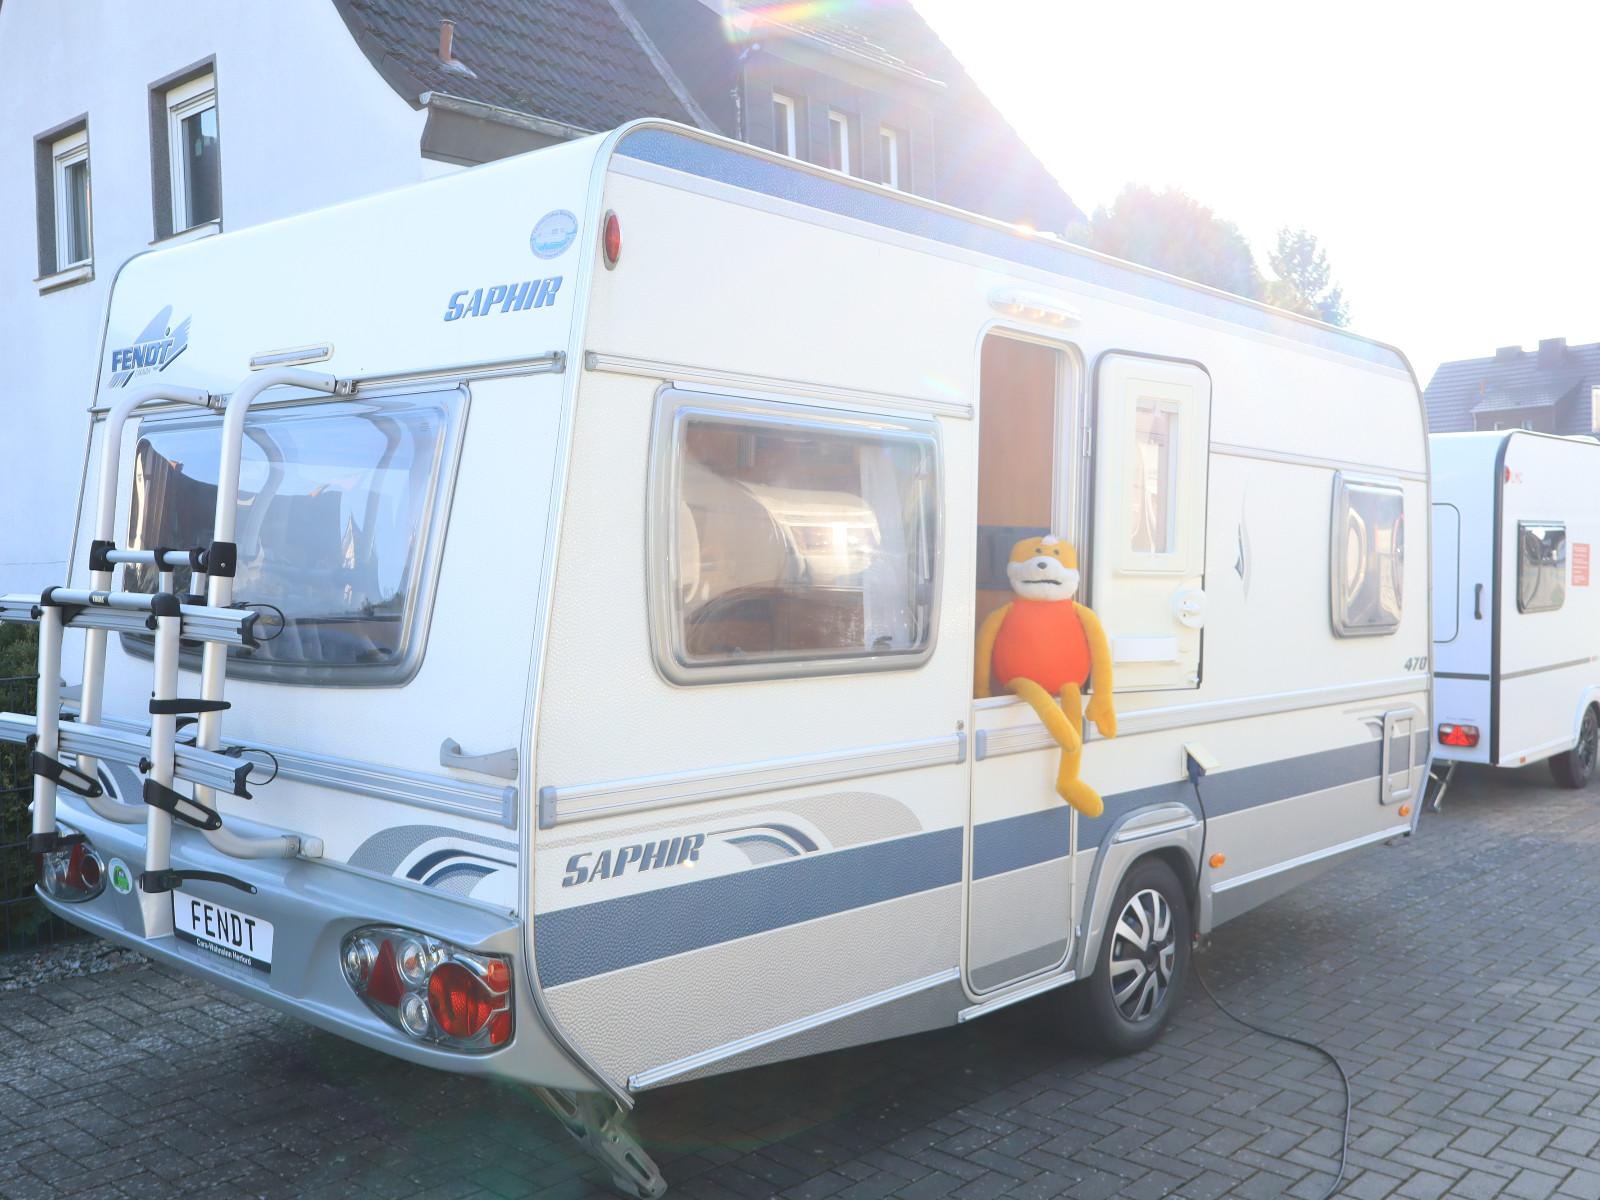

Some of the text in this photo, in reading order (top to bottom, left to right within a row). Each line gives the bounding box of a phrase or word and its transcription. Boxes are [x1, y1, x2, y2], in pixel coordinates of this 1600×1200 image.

[443, 275, 563, 322] SAPHIR
[111, 339, 174, 373] FENDT
[1404, 655, 1428, 671] 470
[561, 833, 705, 888] SAPHIR
[191, 900, 256, 952] FENDT
